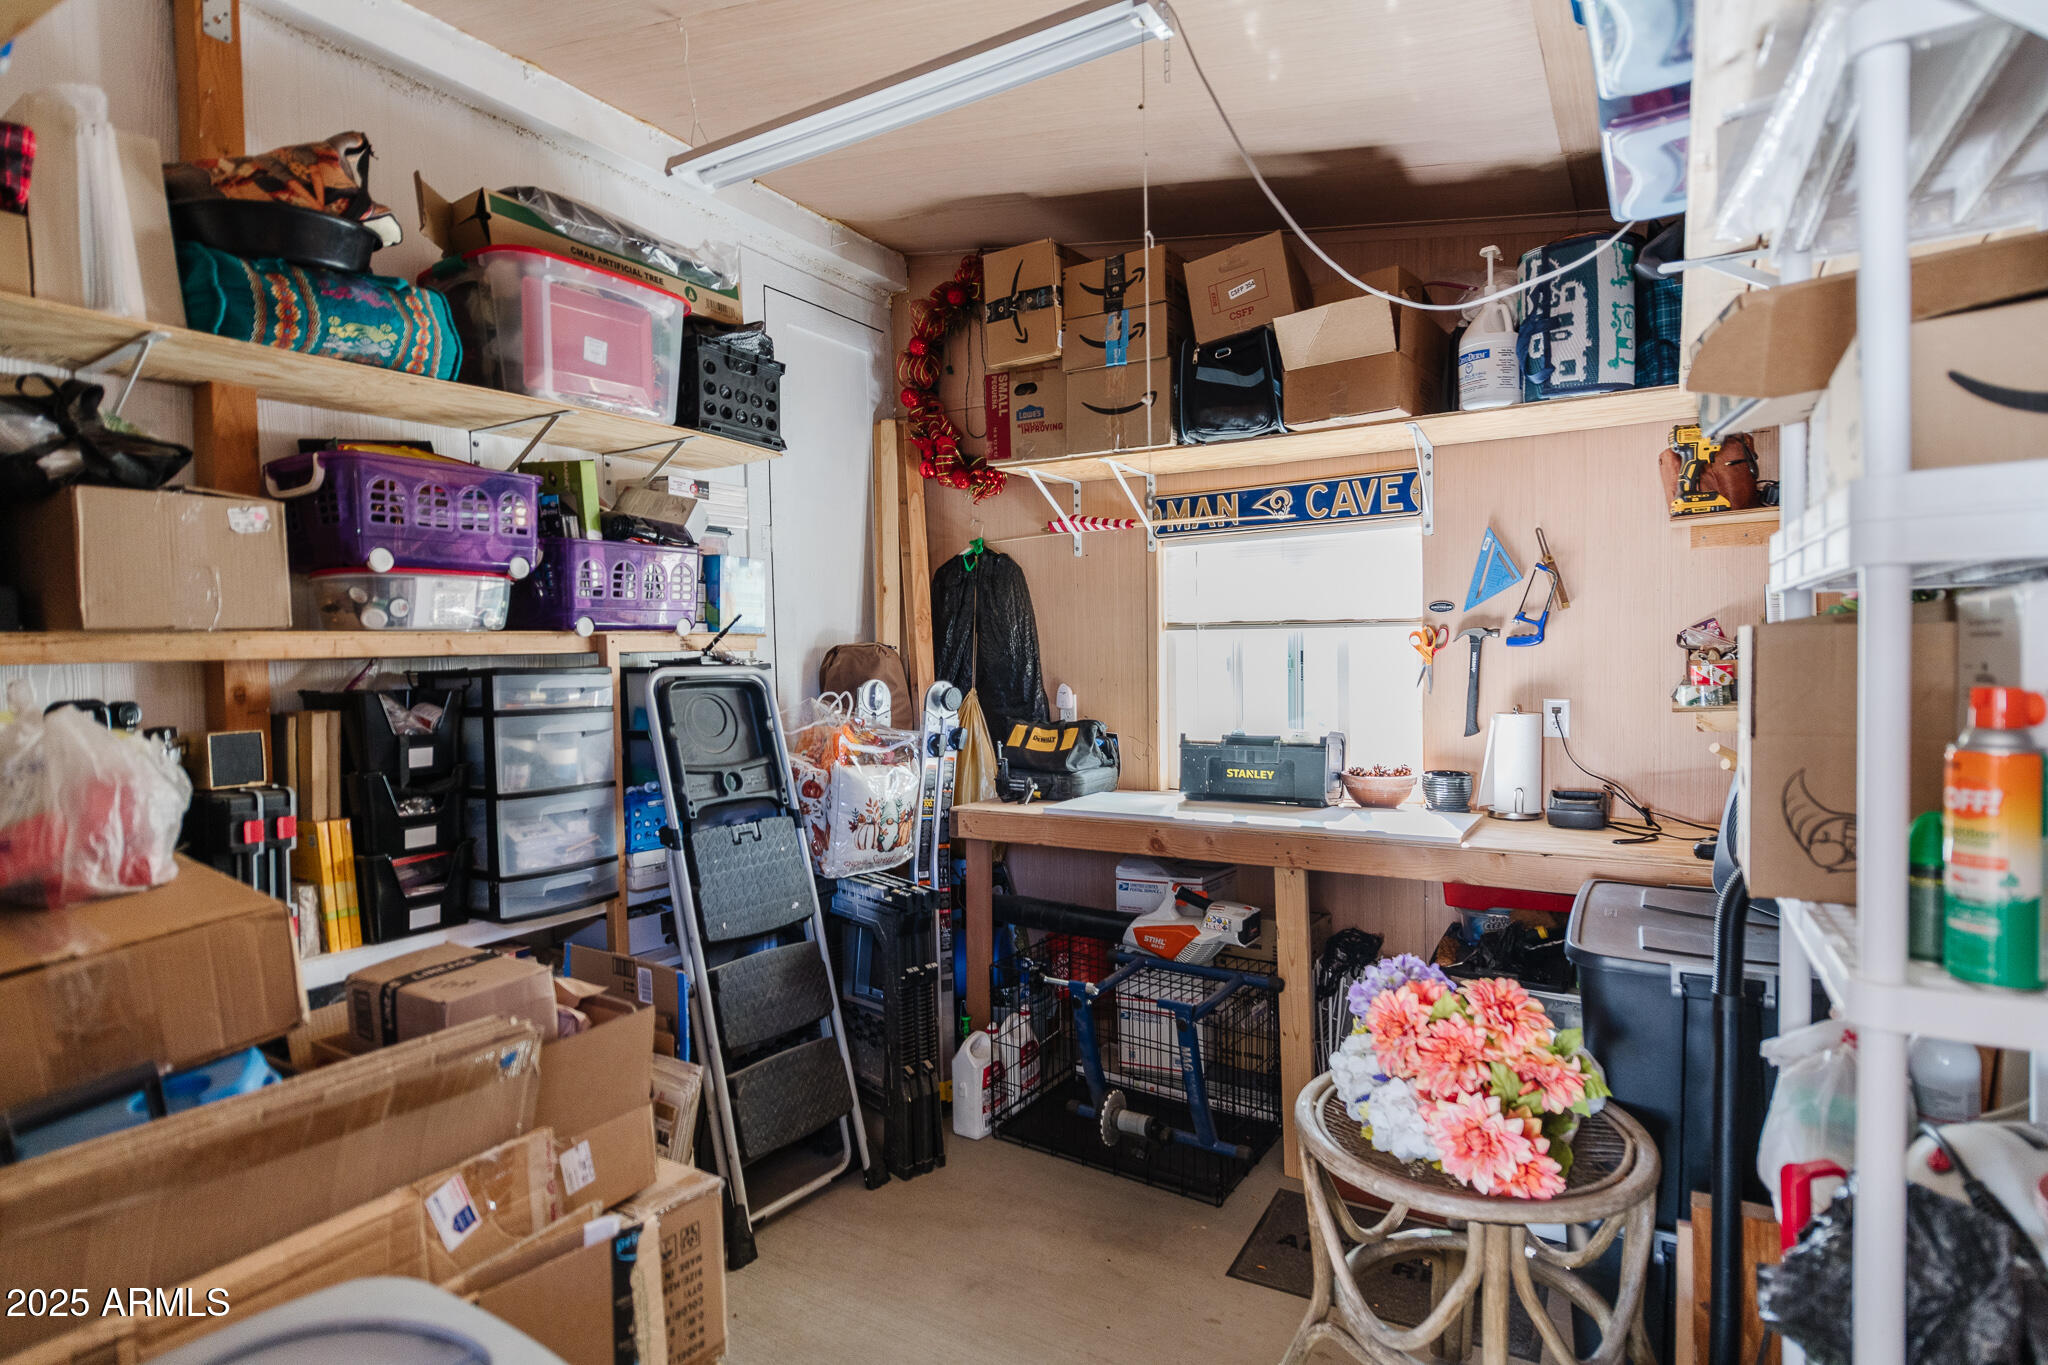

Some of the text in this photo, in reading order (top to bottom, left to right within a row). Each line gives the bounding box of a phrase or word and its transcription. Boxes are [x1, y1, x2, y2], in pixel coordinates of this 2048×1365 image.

[570, 246, 664, 286] CMAS ARTIFICIAL TREE
[1229, 306, 1255, 321] CSFP
[998, 374, 1009, 417] SMALL
[1021, 422, 1064, 434] IMPROVING
[1166, 475, 1404, 532] MAN CAVE
[1226, 768, 1275, 780] STANLEY
[1144, 935, 1166, 946] STIHL
[1181, 1046, 1194, 1072] MAG
